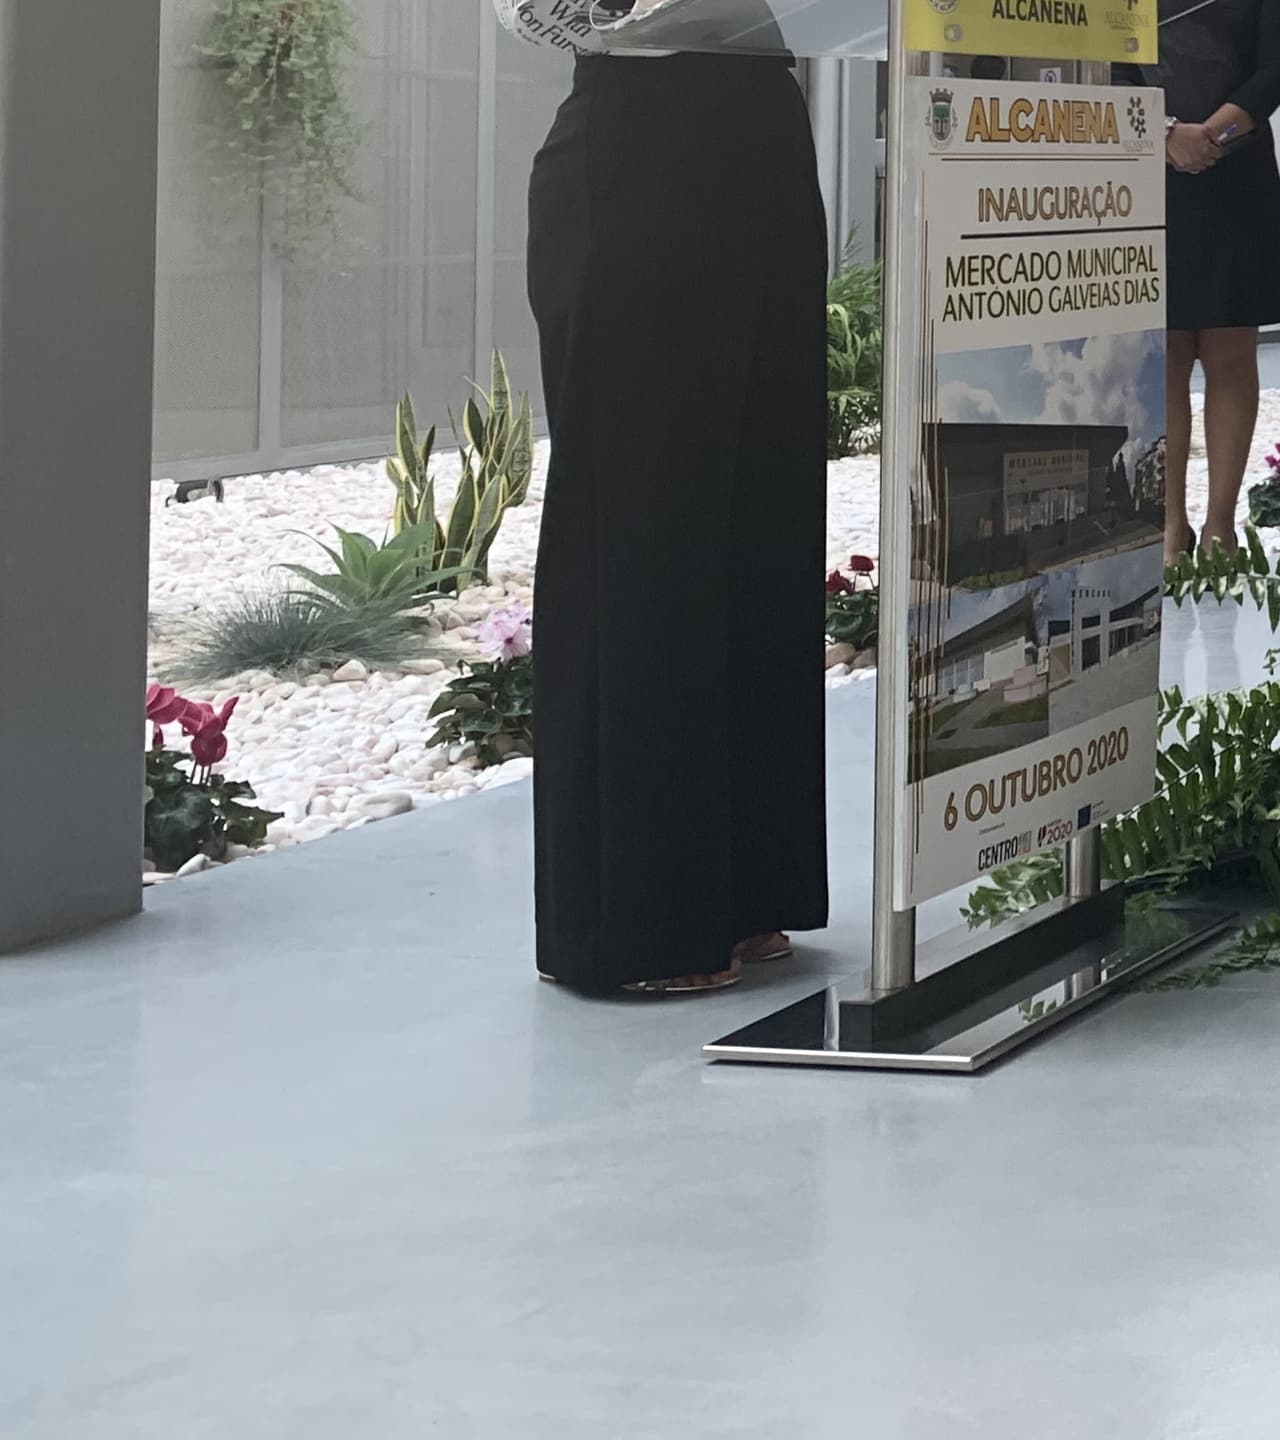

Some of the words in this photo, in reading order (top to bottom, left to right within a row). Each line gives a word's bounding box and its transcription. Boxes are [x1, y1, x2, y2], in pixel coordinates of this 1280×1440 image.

[965, 96, 1120, 144] ALCANENA
[977, 181, 1133, 226] INAUGURAÇÃO
[945, 250, 1062, 288] MERCADO
[1067, 245, 1158, 279] MUNICIPAL
[942, 284, 1044, 322] ANTÓNIO
[1049, 279, 1120, 313] GALVEIAS
[1124, 277, 1160, 305] DIAS
[944, 791, 959, 831] 6
[964, 747, 1083, 822] OUTUBRO
[1087, 726, 1130, 777] 2020
[1046, 820, 1073, 845] 2020
